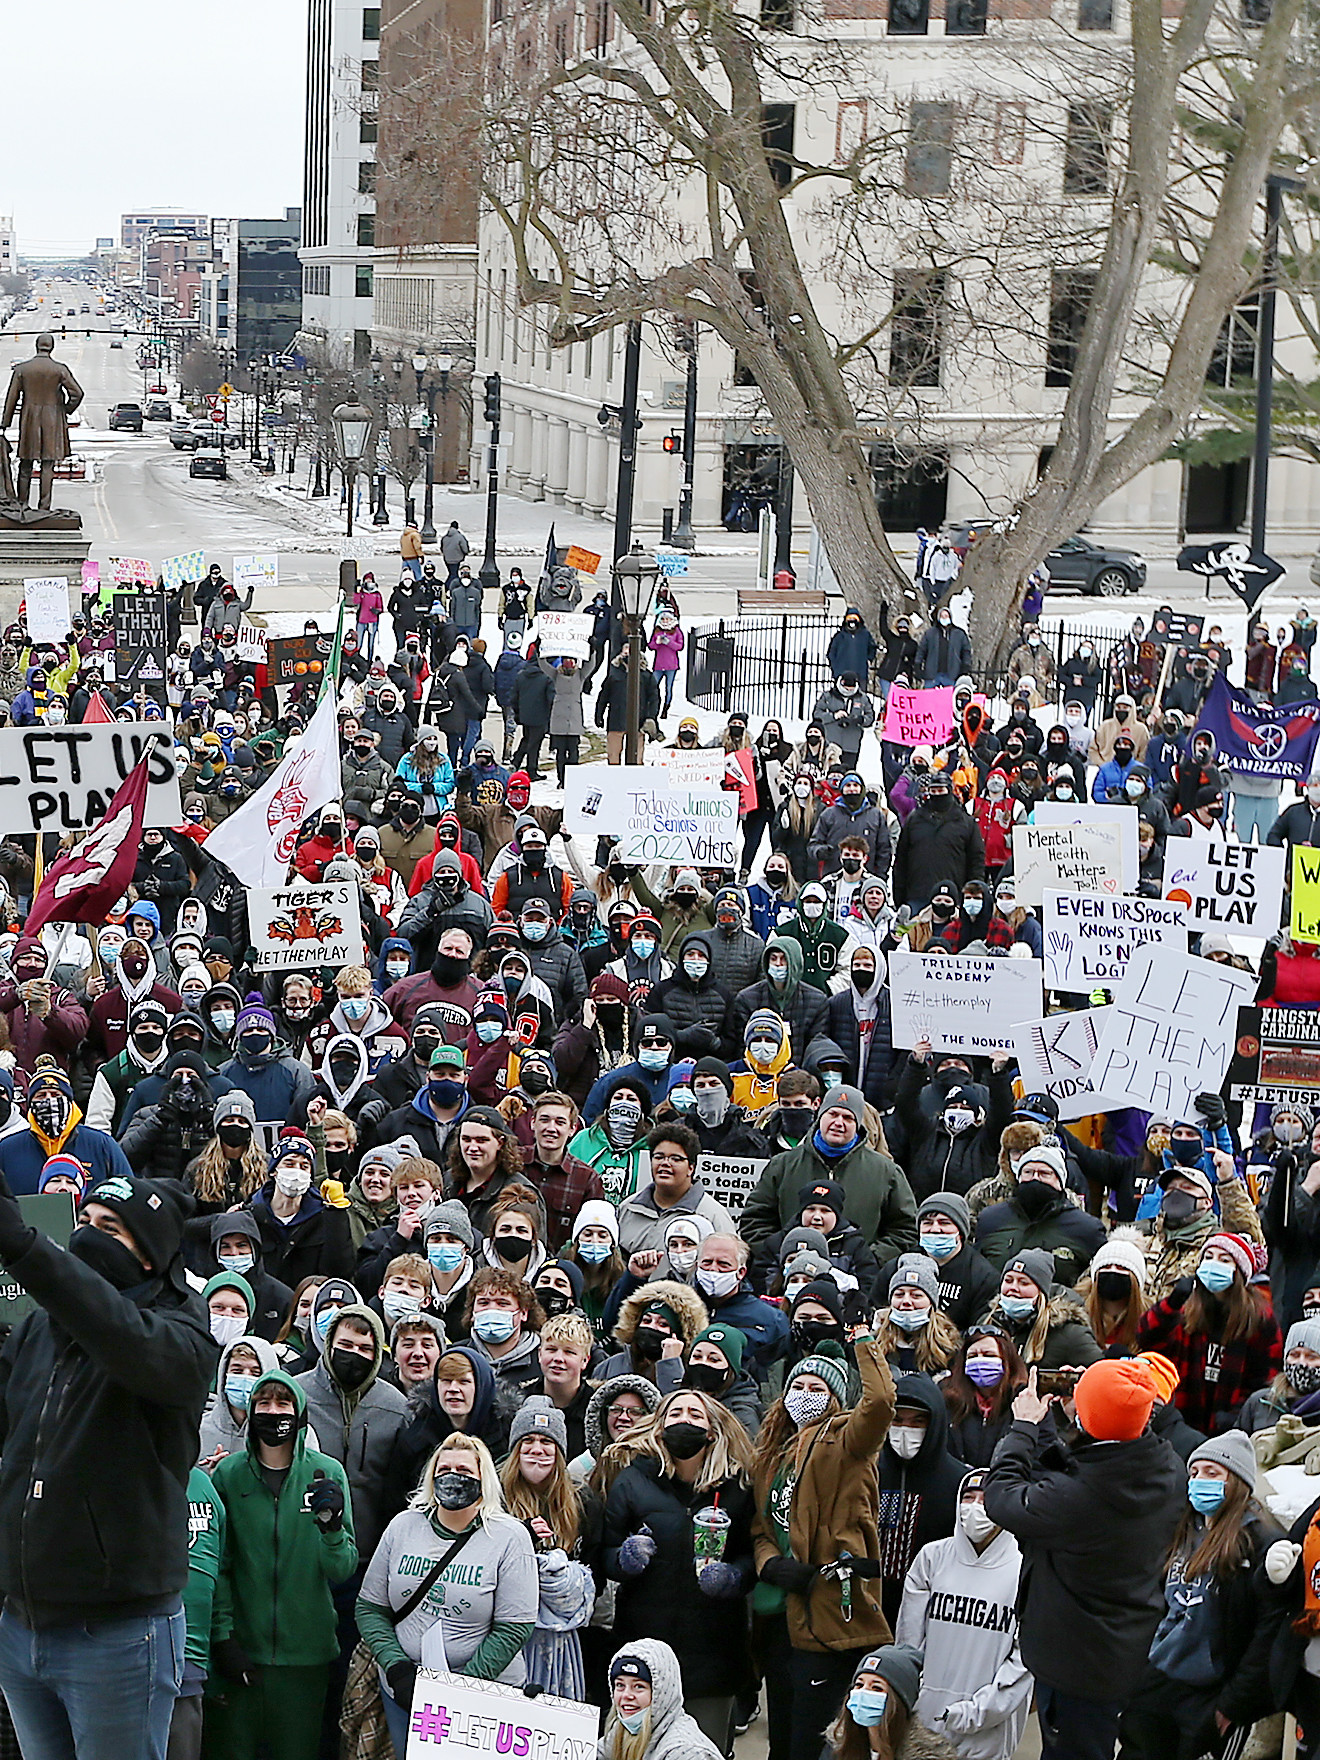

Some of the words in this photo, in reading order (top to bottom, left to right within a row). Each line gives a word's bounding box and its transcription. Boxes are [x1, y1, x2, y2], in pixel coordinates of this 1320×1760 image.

[124, 598, 157, 612] LET
[118, 613, 161, 629] THEM
[116, 630, 164, 647] PLAY!
[892, 695, 916, 710] LET
[897, 712, 933, 724] THEM
[901, 725, 948, 740] PLAY!
[113, 732, 175, 784] US
[1218, 751, 1304, 777] RAMBLERS
[627, 790, 680, 818] Today's
[683, 792, 732, 818] Juniors
[628, 817, 650, 830] and
[653, 815, 697, 832] Seniors
[705, 820, 724, 833] are
[627, 835, 684, 860] 2022
[686, 836, 734, 863] Voters
[1028, 832, 1073, 848] Mental
[1048, 848, 1089, 861] Health
[1208, 843, 1258, 869] LET
[1058, 864, 1106, 878] Matters
[1171, 869, 1198, 884] Cal
[1216, 871, 1255, 897] US
[272, 888, 349, 908] TIGERS
[1056, 897, 1104, 917] EVEN
[1112, 902, 1133, 920] DR
[1132, 901, 1186, 927] SPOCK
[1195, 896, 1257, 925] PLAY
[1079, 922, 1124, 939] KNOWS
[1129, 926, 1162, 942] THIS
[1099, 944, 1111, 956] IS
[921, 958, 995, 971] TRILLIUM
[925, 971, 991, 983] ACADEMY
[902, 989, 991, 1013] #letthemplay
[1137, 959, 1247, 1027] LET
[942, 1035, 964, 1044] THE
[1118, 1010, 1225, 1077] THEM
[1100, 1049, 1202, 1117] PLAY
[701, 1160, 755, 1175] School
[398, 1554, 484, 1586] COOPSVILLE
[401, 1588, 472, 1617] BONCOS
[412, 1703, 596, 1760] #LETUSPLAY
